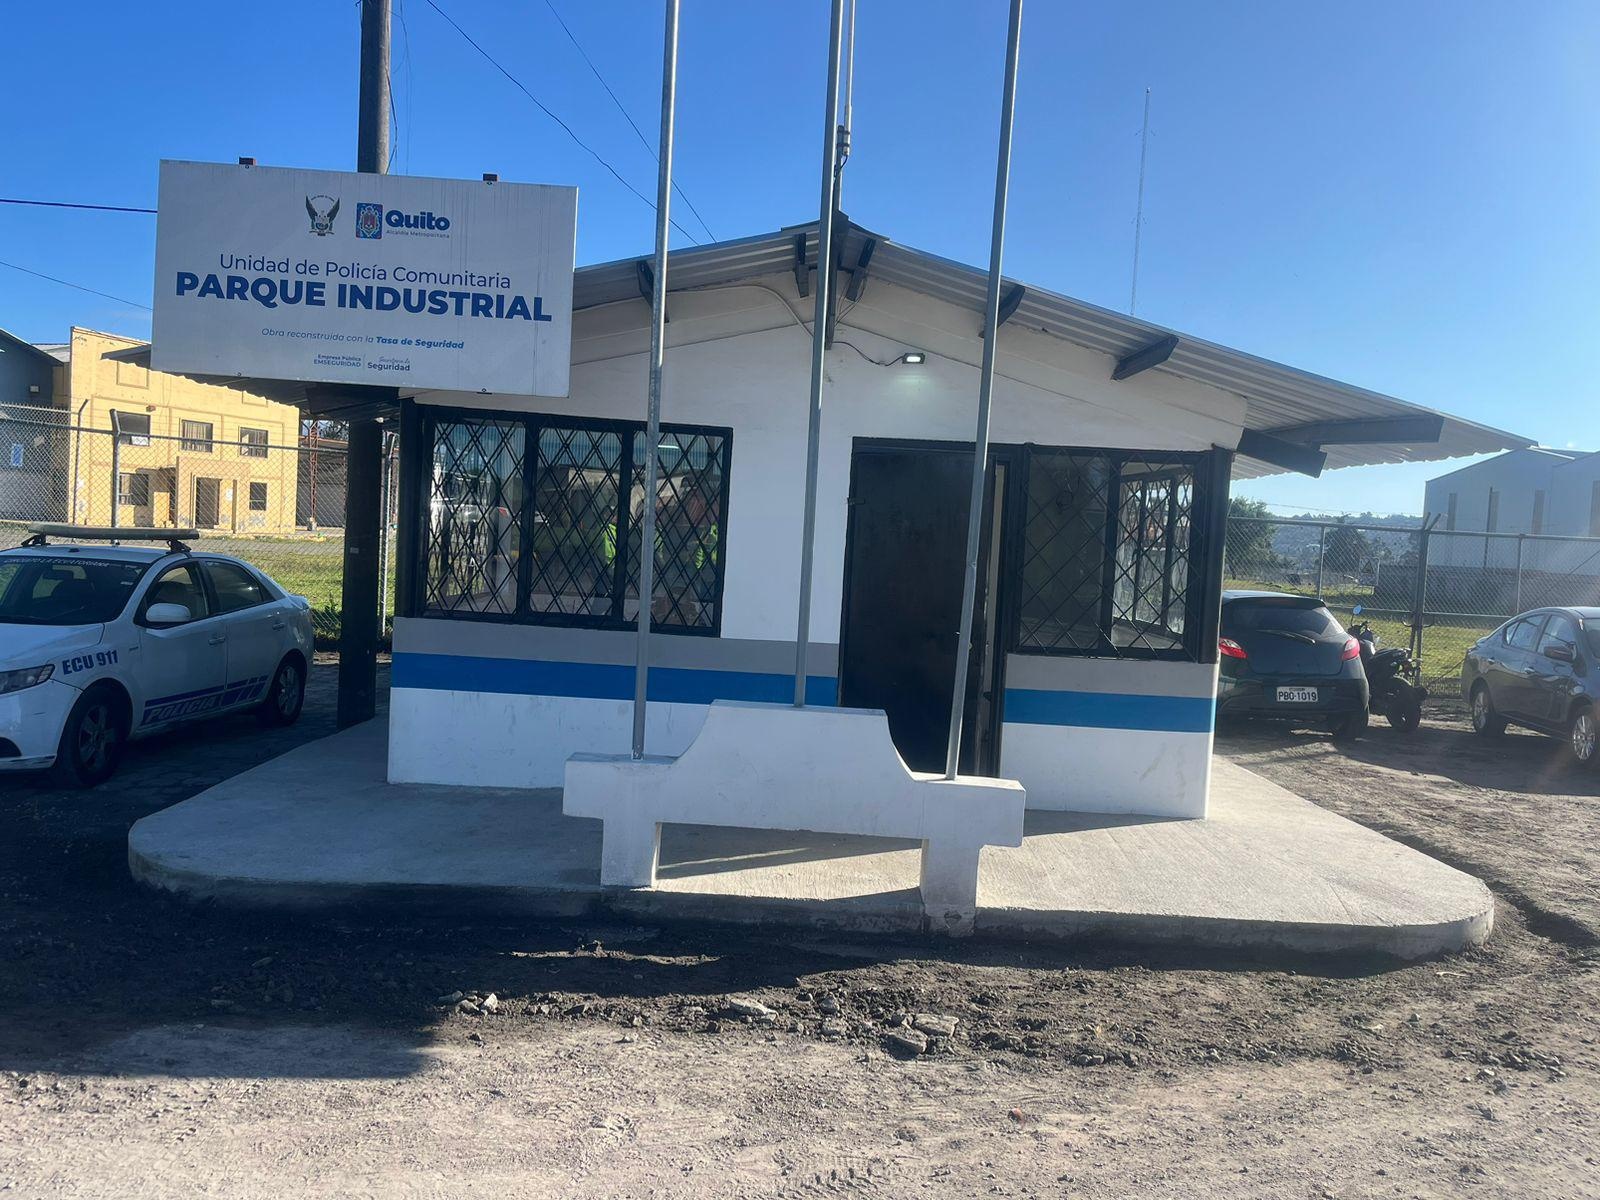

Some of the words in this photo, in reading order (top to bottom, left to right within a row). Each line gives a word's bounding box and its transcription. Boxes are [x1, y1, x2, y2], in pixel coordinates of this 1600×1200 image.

[385, 209, 450, 231] Quito
[220, 253, 290, 274] Unidad
[295, 259, 320, 276] de
[325, 261, 388, 281] Policía
[393, 266, 511, 289] Comunitaria
[176, 271, 326, 309] PARQUE
[337, 283, 553, 322] INDUSTRIAL
[261, 327, 285, 337] Obra
[287, 330, 345, 342] reconstruida
[346, 334, 363, 343] con
[365, 335, 374, 343] la
[376, 336, 399, 345] Tasa
[400, 337, 413, 346] de
[415, 338, 465, 349] Seguridad
[367, 362, 411, 371] Seguridad
[62, 654, 95, 675] ECU
[96, 650, 118, 666] 911
